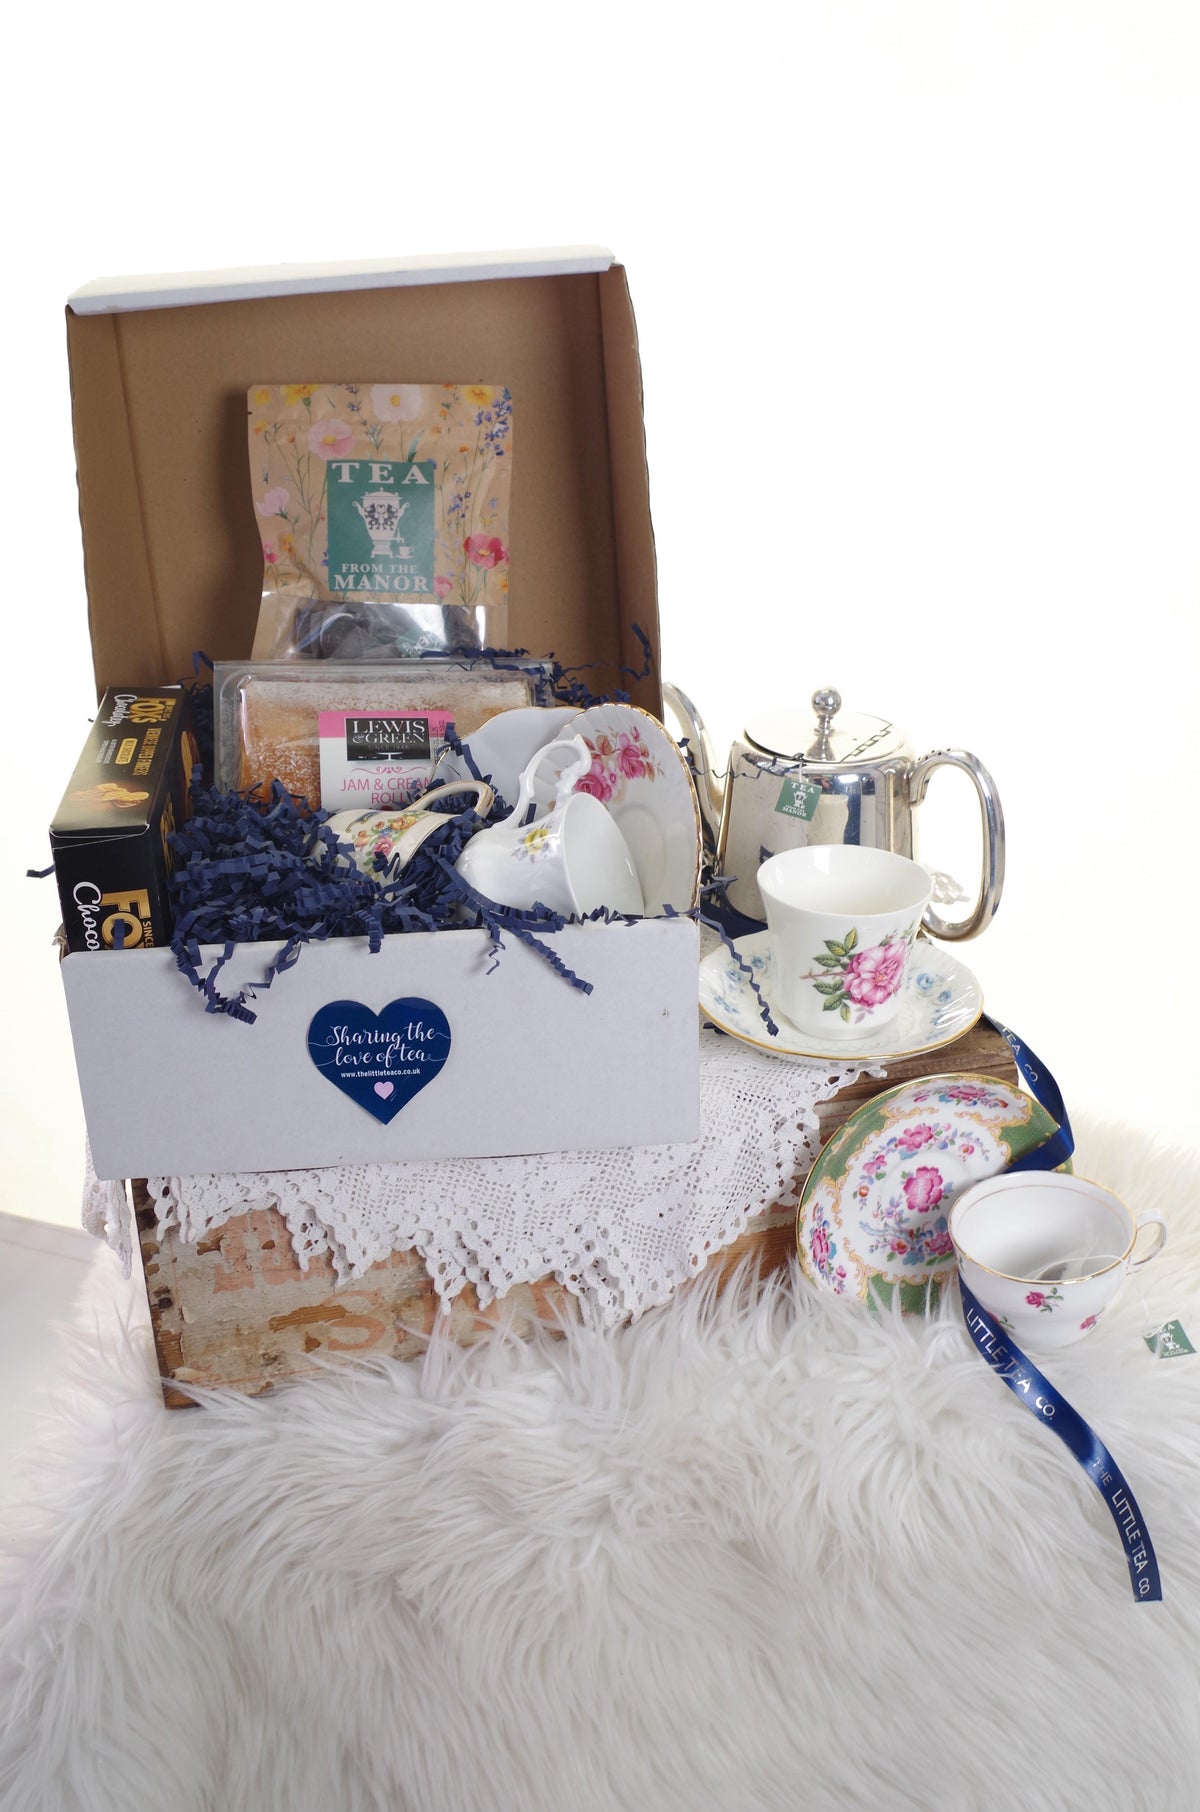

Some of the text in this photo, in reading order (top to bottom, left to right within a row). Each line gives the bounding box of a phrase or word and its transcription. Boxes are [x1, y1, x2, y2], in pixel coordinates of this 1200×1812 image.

[332, 462, 430, 484] TEA
[341, 563, 418, 574] FROM THE
[334, 574, 429, 592] MANOR
[352, 720, 425, 734] LEWIS
[341, 778, 370, 791] JAM
[374, 778, 383, 790] &
[790, 781, 815, 794] TEA
[371, 791, 407, 804] ROLL
[73, 881, 101, 951] Choco
[101, 889, 151, 949] FO
[142, 921, 153, 948] SINCE
[326, 1021, 435, 1049] Sharing the
[1002, 1027, 1022, 1056] TEA
[334, 1043, 431, 1068] love of tea
[340, 1067, 421, 1078] www.thelittleteaco.co.uk
[966, 1308, 1008, 1361] LITTLE
[1111, 1488, 1142, 1545] LITTLE
[1131, 1540, 1149, 1574] TEA
